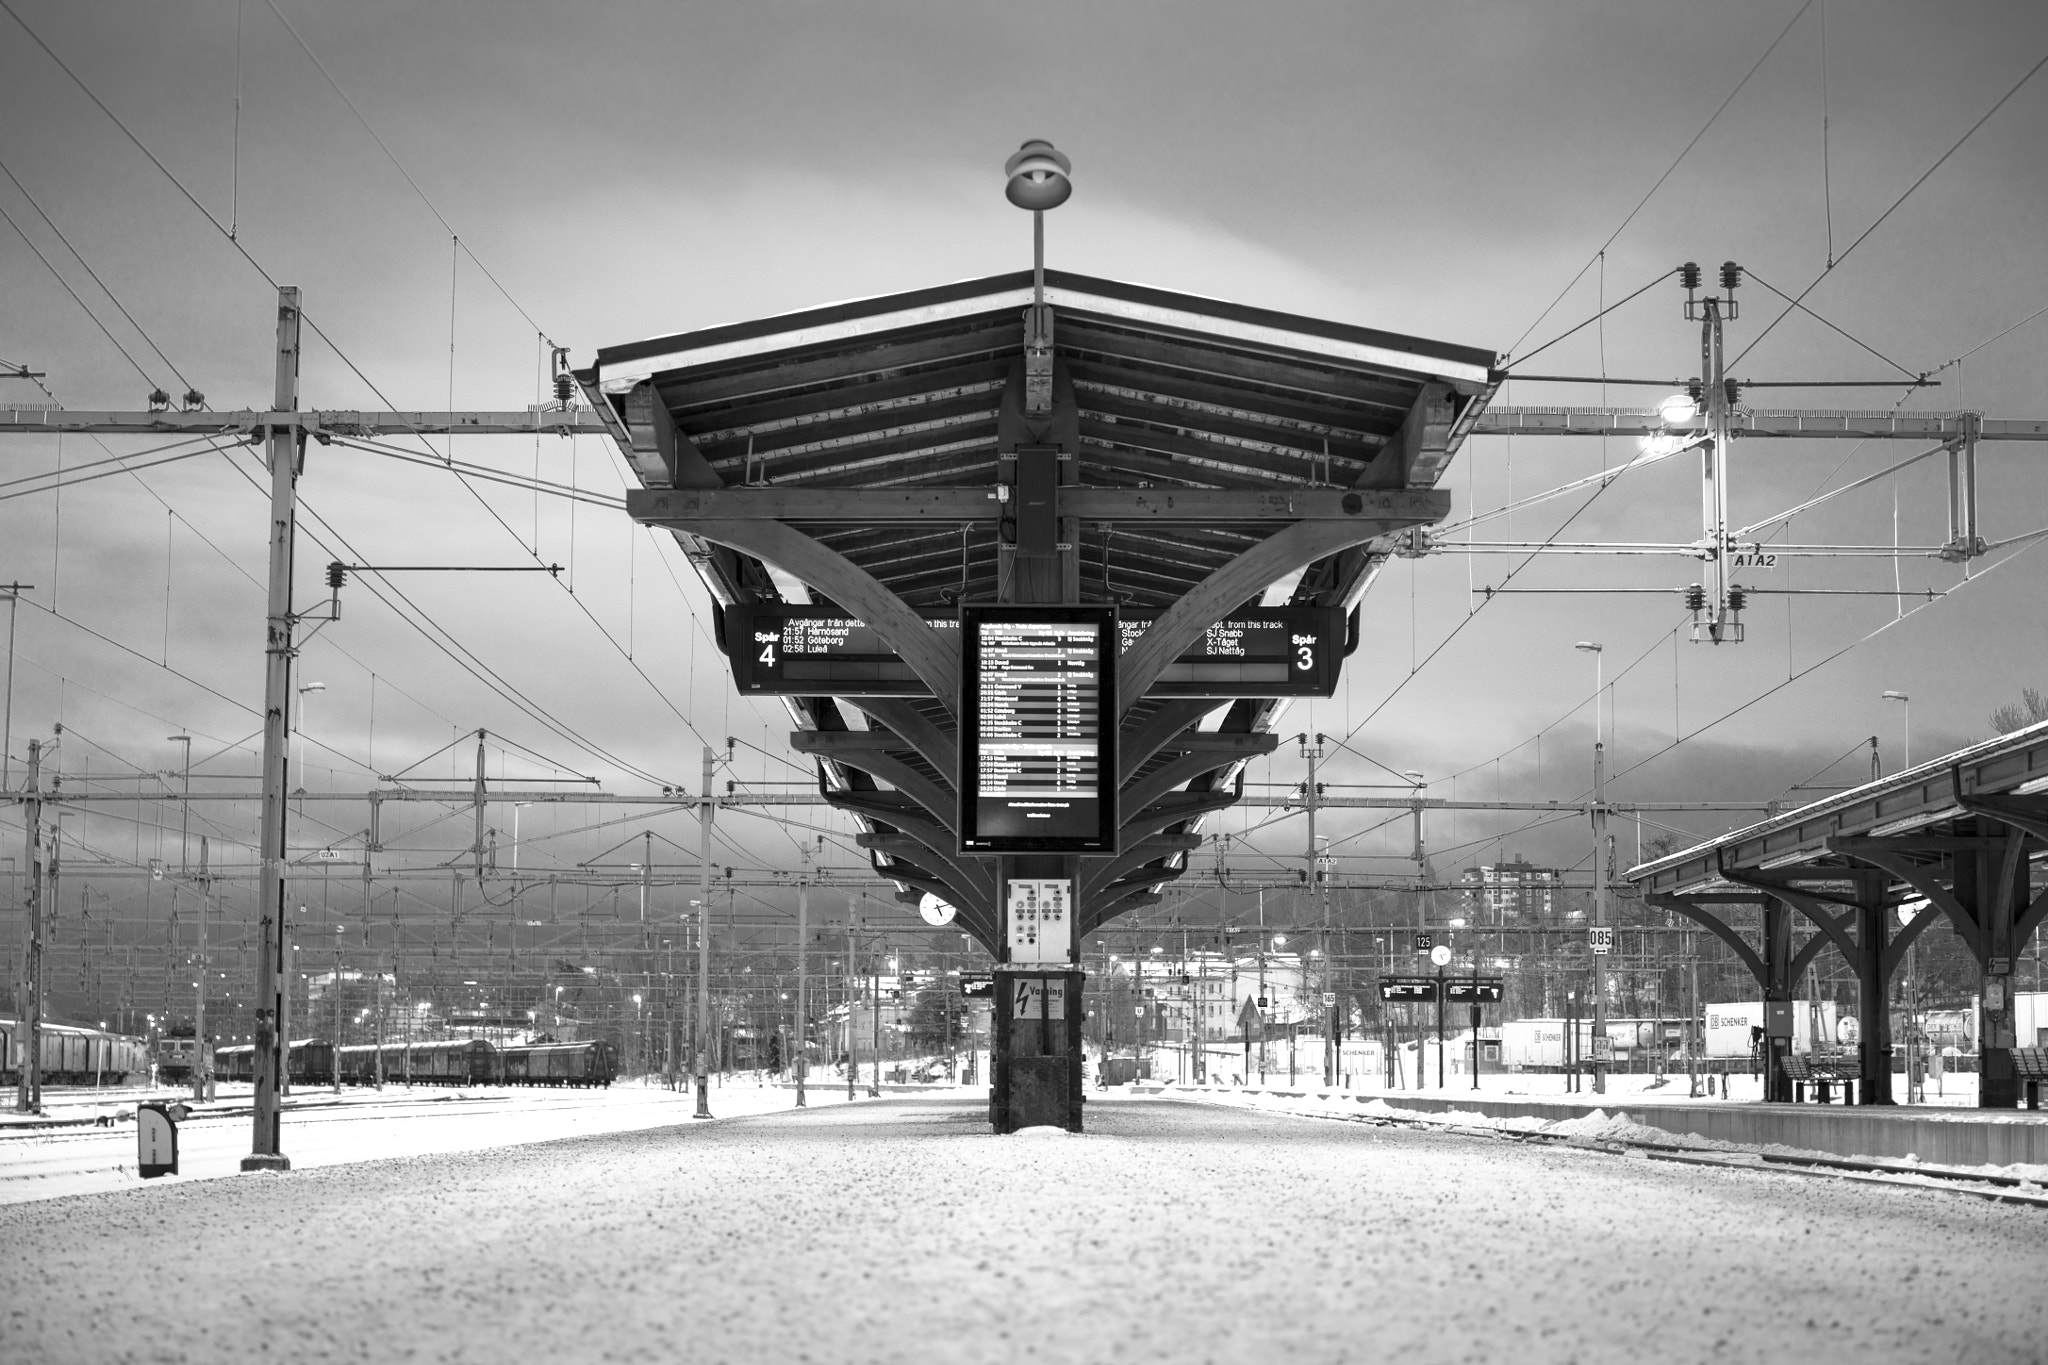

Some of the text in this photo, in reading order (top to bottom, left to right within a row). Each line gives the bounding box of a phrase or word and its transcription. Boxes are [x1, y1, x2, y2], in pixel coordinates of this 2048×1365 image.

[1734, 554, 1776, 567] A1A2
[788, 618, 825, 629] Avgångar
[827, 618, 843, 628] från
[934, 619, 948, 628] this
[1228, 620, 1246, 629] from
[1247, 620, 1261, 629] this
[1262, 620, 1284, 629] track
[783, 626, 849, 636] 21:57 Härnösand
[1206, 629, 1244, 638] SJ Snabb
[754, 631, 780, 644] Spår
[782, 635, 844, 646] 01:52 Göteborg
[1206, 638, 1239, 648] X-Tåget
[1291, 634, 1318, 646] Spår
[782, 644, 828, 654] 02:58 Luleå
[1206, 646, 1246, 657] SJ Nattåg
[759, 644, 776, 667] 4
[1296, 646, 1314, 670] 3
[1417, 936, 1431, 948] 125
[1590, 930, 1611, 945] 085
[1030, 985, 1063, 999] Vaing
[1721, 1017, 1748, 1027] SCHENKER
[1342, 1049, 1375, 1057] SCHENKER
